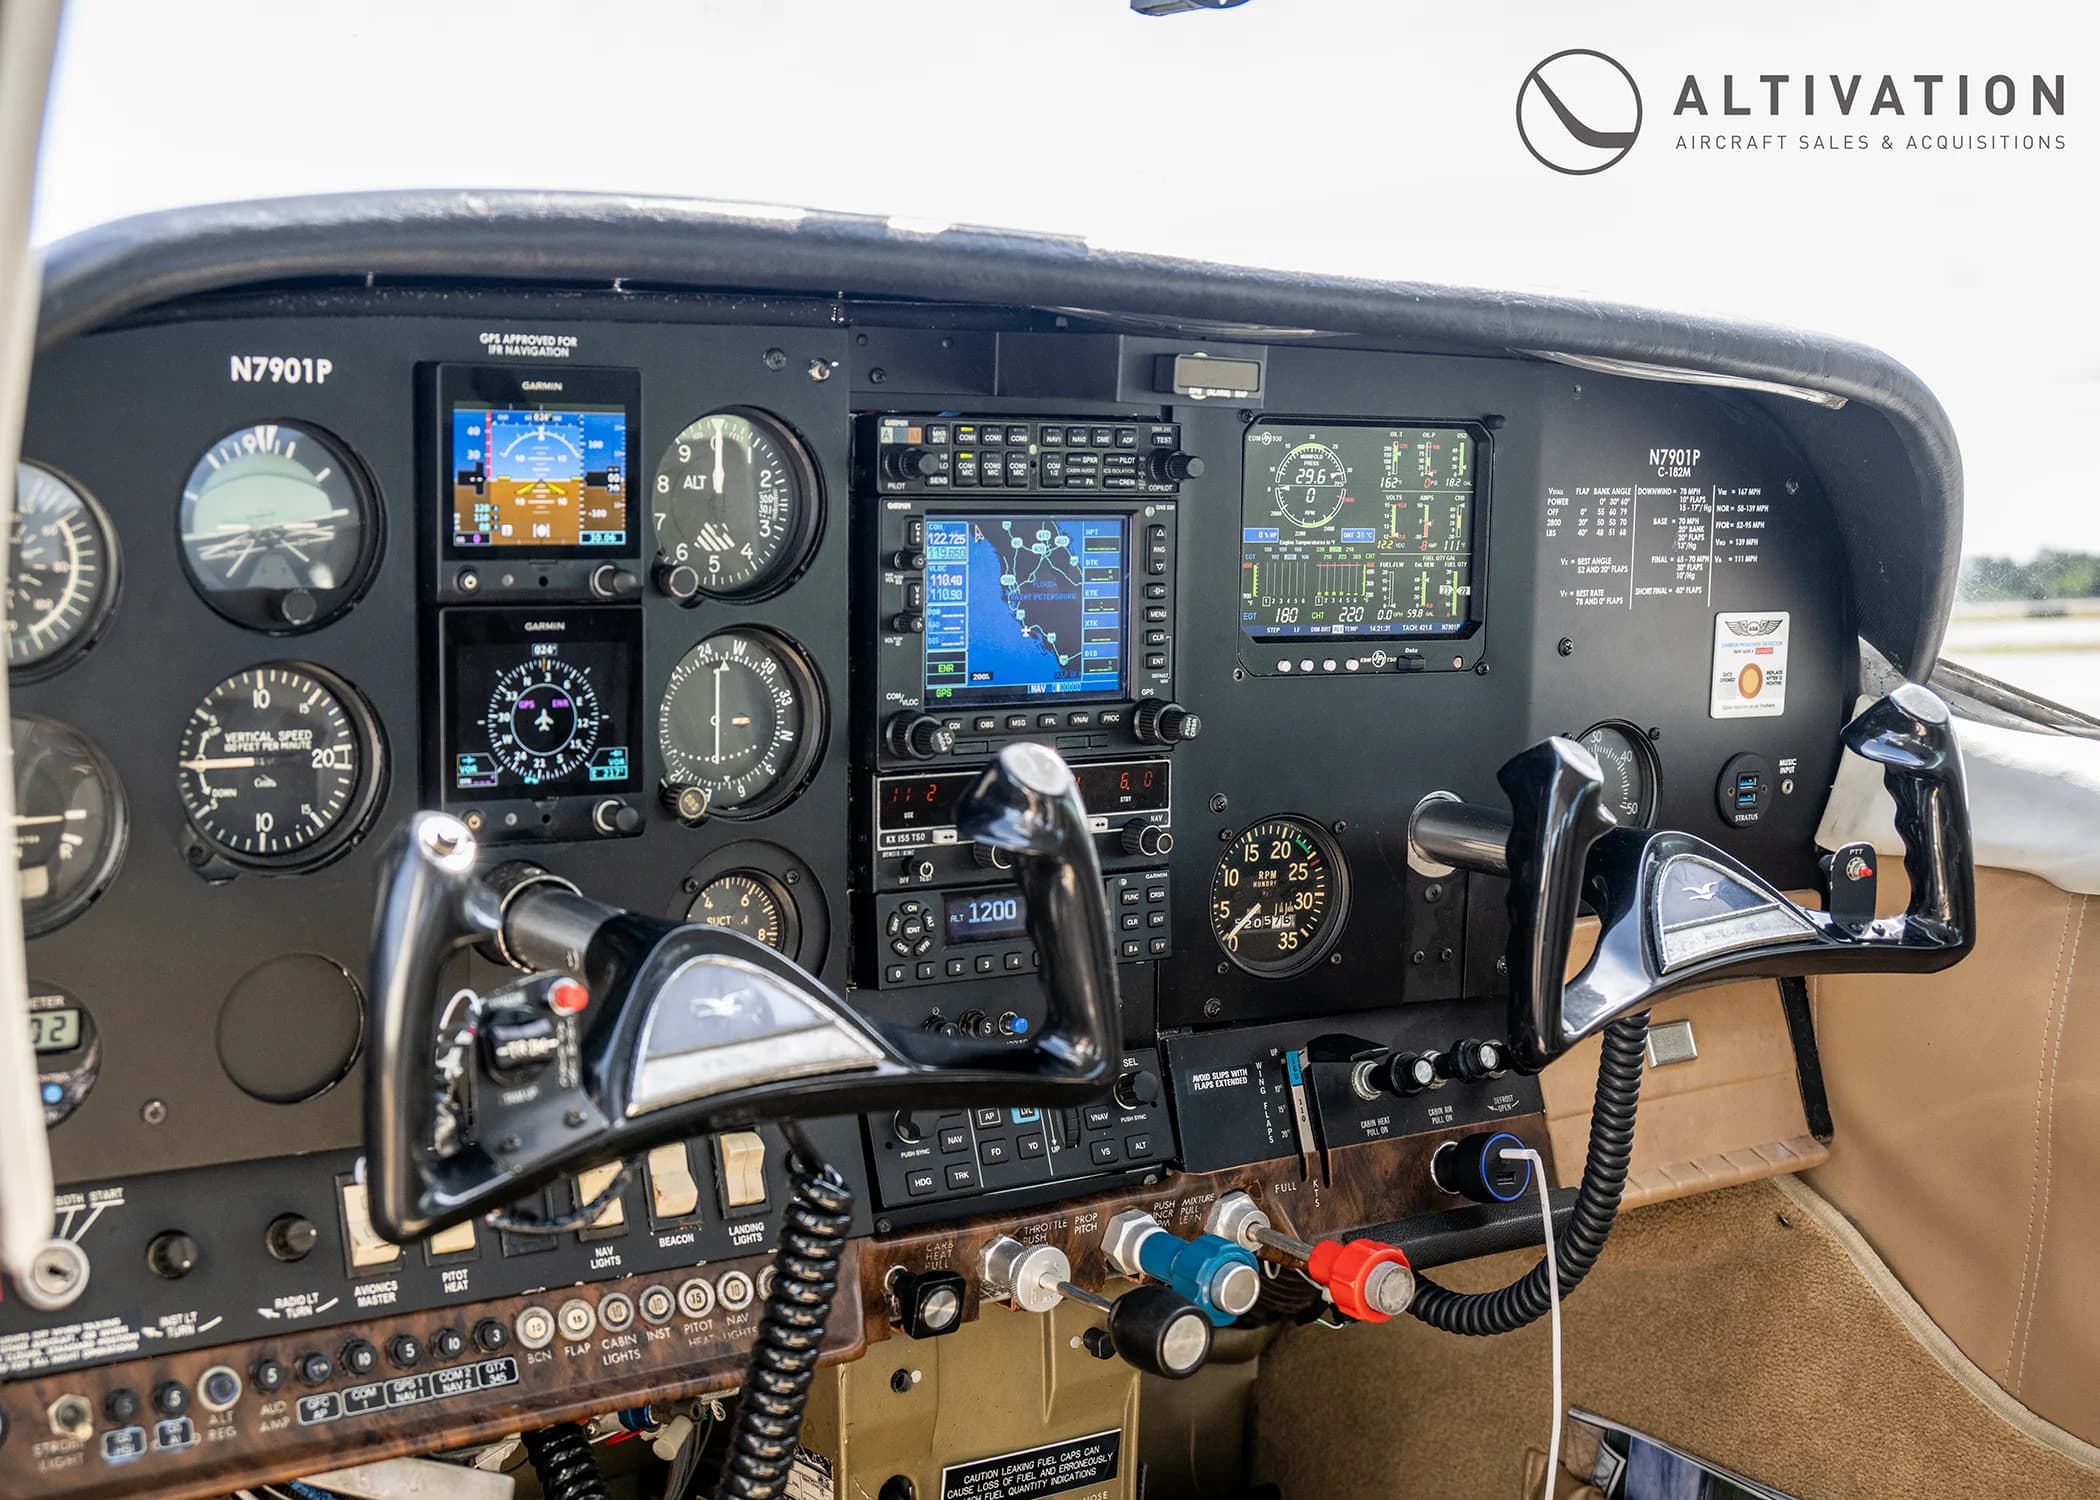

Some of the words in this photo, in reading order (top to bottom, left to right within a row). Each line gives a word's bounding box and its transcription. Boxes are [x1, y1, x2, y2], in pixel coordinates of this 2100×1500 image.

[480, 333, 500, 344] GPS
[502, 334, 555, 346] APPROVED
[557, 336, 577, 347] FOR
[488, 345, 503, 355] IFR
[505, 346, 569, 357] NAVIGATION
[230, 355, 333, 384] N7901P
[521, 381, 563, 391] GARMIN
[1046, 435, 1061, 443] NAV1
[1121, 436, 1134, 444] ADF
[678, 445, 691, 463] 9
[1650, 449, 1700, 466] N7901P
[760, 470, 772, 487] 2
[1296, 468, 1326, 485] 29.6
[1658, 467, 1691, 478] C-182M
[657, 475, 669, 493] 8
[683, 475, 707, 490] ALT
[1148, 484, 1172, 492] COPILOT
[654, 513, 666, 531] 7
[1653, 517, 1668, 525] BASE
[759, 520, 771, 537] 3
[928, 533, 966, 545] 122.725
[676, 543, 688, 561] 6
[740, 543, 754, 560] 4
[708, 555, 720, 573] 5
[1591, 557, 1612, 565] ANGLE
[930, 589, 963, 600] 110.90
[1275, 607, 1299, 623] 180
[1311, 612, 1325, 620] CHT
[1338, 607, 1364, 622] 220
[524, 622, 566, 631] GARMIN
[938, 664, 954, 673] ENR
[936, 689, 952, 698] GPS
[1031, 684, 1046, 693] NAV
[253, 689, 270, 709] 10
[1011, 719, 1026, 727] MSG
[1073, 716, 1088, 724] VNAV
[1103, 714, 1120, 722] PROC
[981, 721, 994, 729] OBS
[224, 732, 274, 743] VERTICAL
[278, 729, 312, 741] SPEED
[238, 742, 261, 752] FEET
[262, 742, 279, 751] PER
[280, 741, 312, 750] MINUTE
[312, 749, 335, 768] 20
[1779, 758, 1797, 766] MUSIC
[1780, 766, 1795, 774] INPUT
[256, 812, 274, 832] 10
[1150, 814, 1163, 822] NAV
[1735, 813, 1758, 822] STRATUS
[886, 833, 897, 843] KX
[898, 832, 910, 842] 155
[912, 831, 925, 842] TSO
[1244, 844, 1259, 862] 15
[1270, 841, 1291, 859] 20
[1145, 872, 1168, 880] GARMIN
[1224, 869, 1239, 887] 10
[1258, 870, 1277, 879] RPM
[1288, 863, 1308, 881] 25
[1124, 893, 1139, 901] FUNC
[1294, 892, 1313, 910] 30
[950, 913, 964, 922] ALT
[968, 900, 1017, 923] 1200
[1219, 900, 1230, 918] 5
[1127, 917, 1138, 926] CLR
[1153, 916, 1164, 924] ENT
[1278, 932, 1298, 949] 35
[1270, 1048, 1278, 1056] UP
[1122, 1057, 1138, 1067] SEL
[1192, 1073, 1211, 1083] AVOID
[1212, 1071, 1230, 1080] SLIPS
[1230, 1069, 1248, 1078] WITH
[1194, 1081, 1214, 1091] FLAPS
[1215, 1076, 1248, 1088] EXTENDED
[1255, 1061, 1267, 1095] WING
[1263, 1101, 1274, 1144] FLAPS
[985, 1111, 995, 1121] AP
[1090, 1112, 1109, 1122] VNAV
[1428, 1107, 1443, 1117] CABIN
[1444, 1105, 1453, 1114] AIR
[1134, 1114, 1147, 1122] SYNC
[1360, 1119, 1376, 1129] CABIN
[1377, 1116, 1391, 1125] HEAT
[1432, 1116, 1445, 1125] PULL
[1446, 1114, 1453, 1122] ON
[1367, 1128, 1379, 1137] PULL
[1380, 1127, 1389, 1135] ON
[947, 1135, 963, 1145] NAV
[1027, 1141, 1038, 1151] YD
[1135, 1141, 1147, 1150] ALT
[991, 1147, 1001, 1157] FD
[1101, 1147, 1110, 1156] VS
[914, 1176, 932, 1187] HDG
[953, 1171, 969, 1181] TRK
[1274, 1182, 1297, 1194] FULL
[89, 1188, 124, 1203] START
[1181, 1193, 1216, 1206] MIXTURE
[1154, 1200, 1175, 1210] PUSH
[1074, 1212, 1098, 1225] PROP
[728, 1222, 764, 1236] LANDING
[1074, 1223, 1098, 1235] PITCH
[659, 1233, 695, 1248] BEACON
[733, 1232, 763, 1245] LIGHTS
[595, 1246, 614, 1257] NAV
[590, 1255, 622, 1269] LIGHTS
[442, 1269, 468, 1282] PITOT
[354, 1280, 398, 1297] AVIONICS
[444, 1280, 468, 1293] HEAT
[357, 1292, 397, 1307] MASTER
[726, 1314, 749, 1325] NAV
[684, 1320, 713, 1334] PITOT
[646, 1327, 671, 1341] INST
[448, 1338, 460, 1349] 10
[602, 1335, 637, 1350] CABIN
[405, 1343, 415, 1357] 5
[564, 1343, 591, 1356] FLAP
[527, 1350, 552, 1364] BCN
[603, 1350, 641, 1366] LIGHTS
[485, 1361, 507, 1373] GTX
[963, 1469, 998, 1485] CAUTION
[1001, 1460, 1035, 1475] LEAKING
[1037, 1456, 1057, 1467] FUEL
[1060, 1450, 1081, 1462] CAPS
[1084, 1445, 1100, 1457] CAN
[946, 1485, 974, 1499] CAUSE
[977, 1479, 999, 1492] LOSS
[1003, 1477, 1013, 1487] OF
[1016, 1473, 1036, 1484] FUEL
[1040, 1467, 1055, 1478] AND
[1058, 1452, 1113, 1475] ERRONEOUSLY
[984, 1489, 1004, 1500] FUEL
[1008, 1480, 1048, 1496] QUANTITY
[1050, 1467, 1096, 1487] INDICATIONS
